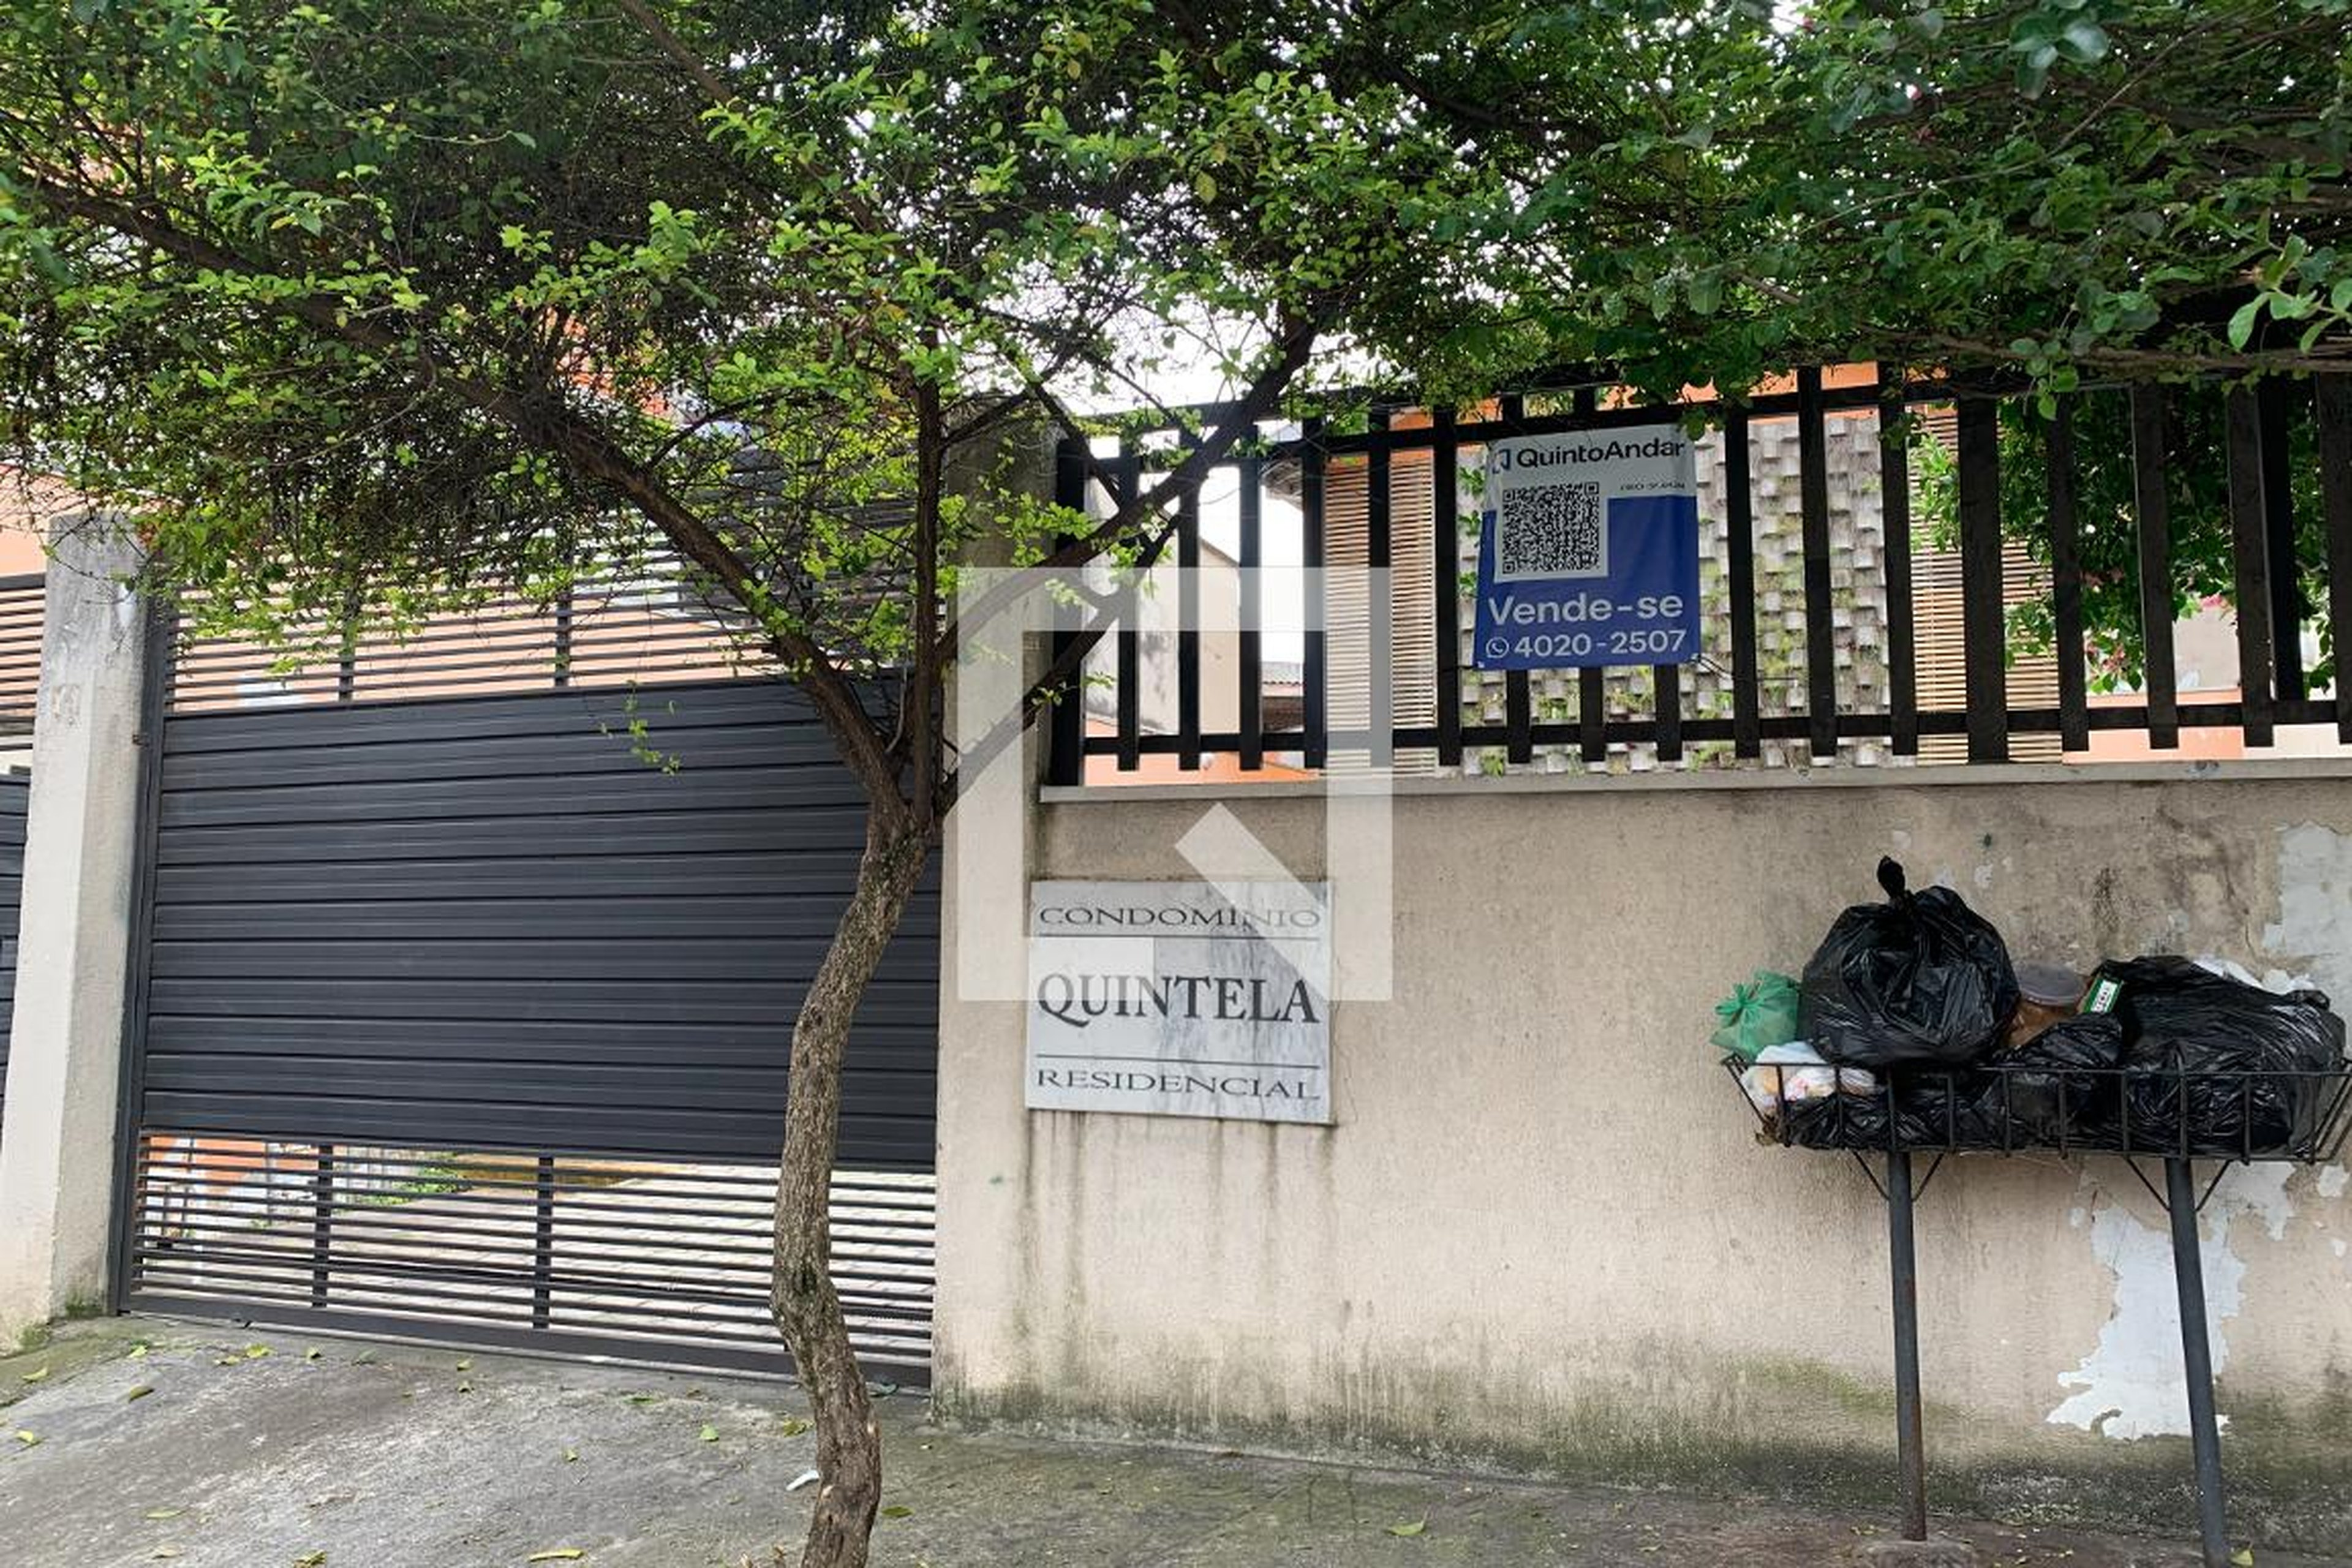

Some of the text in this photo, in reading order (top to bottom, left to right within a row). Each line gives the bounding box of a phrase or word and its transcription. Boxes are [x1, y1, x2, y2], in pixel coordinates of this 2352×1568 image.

[1517, 438, 1684, 467] QuintoAndar
[1488, 593, 1683, 625] Vende-se
[1514, 629, 1686, 657] 4020-2507
[1037, 973, 1321, 1028] QUINTELA
[1038, 1070, 1321, 1099] RESIDENCIAL
